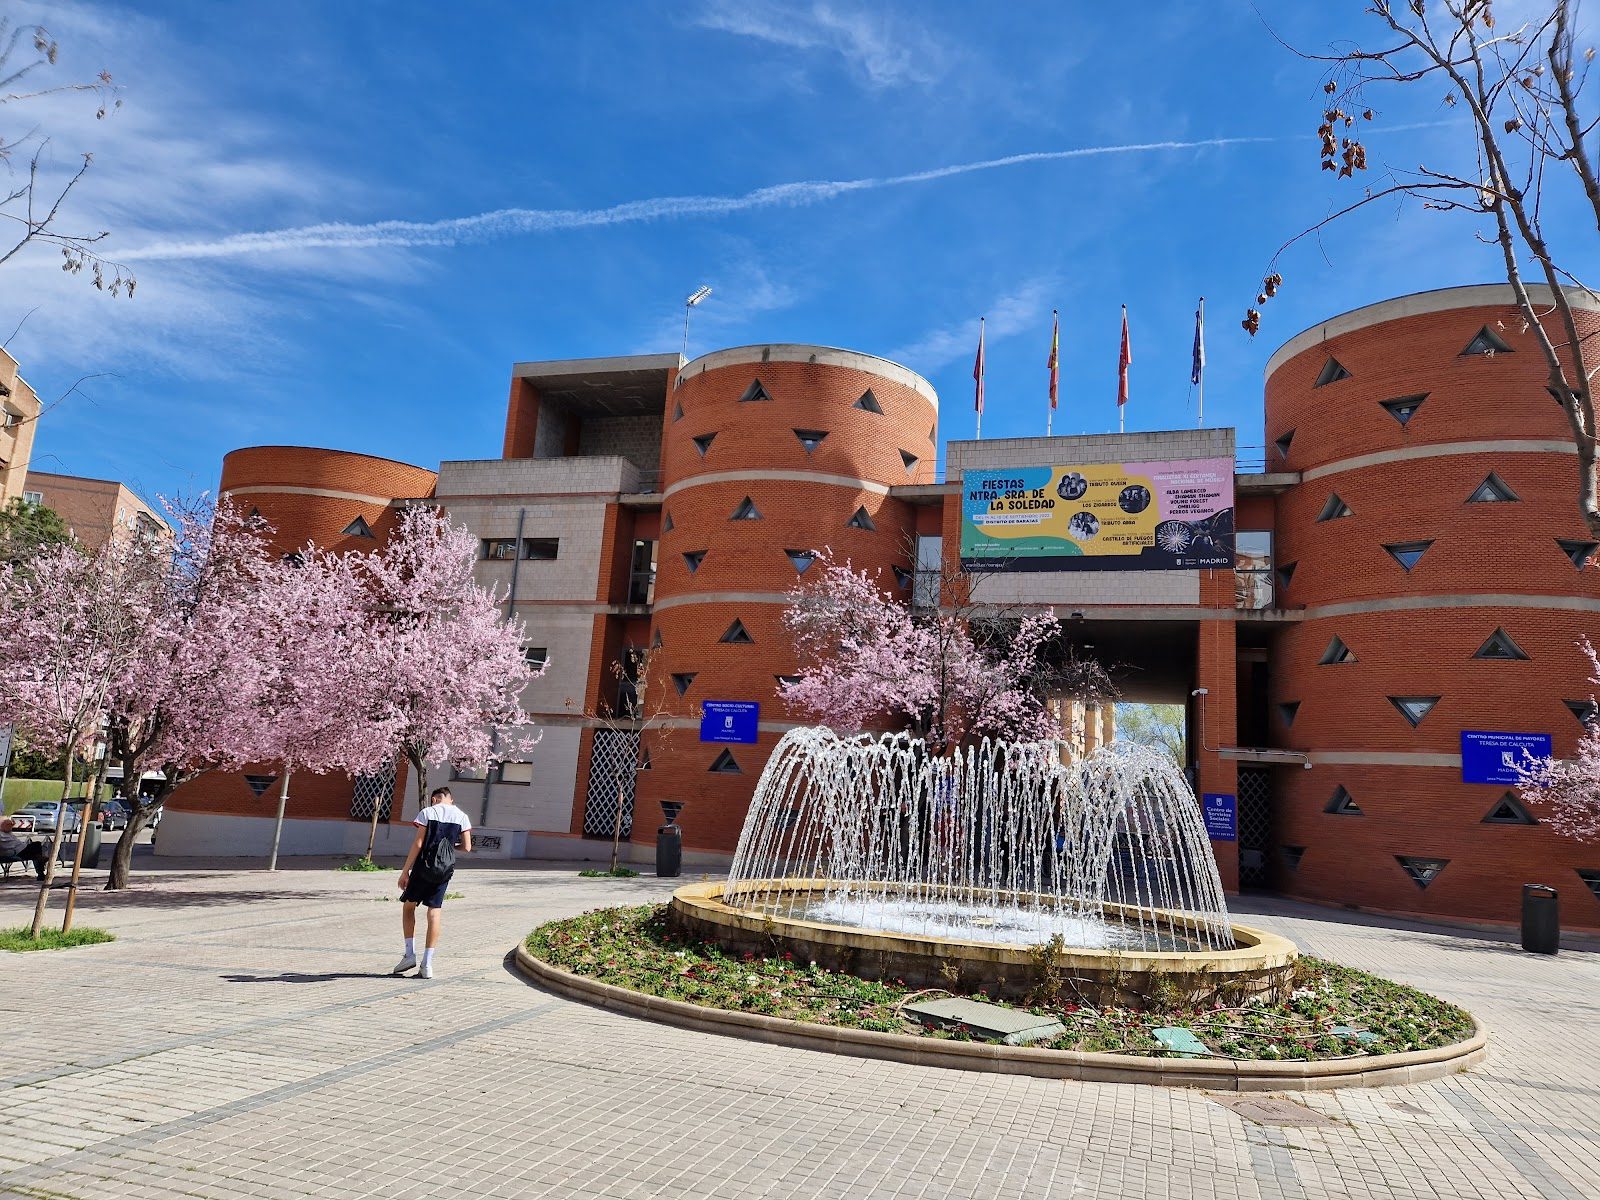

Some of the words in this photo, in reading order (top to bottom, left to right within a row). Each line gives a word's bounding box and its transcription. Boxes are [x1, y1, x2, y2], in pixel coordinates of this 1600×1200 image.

[982, 480, 1024, 490] FIESTAS
[970, 491, 1000, 500] NTRA.
[1004, 490, 1028, 499] SRA.
[1032, 489, 1045, 498] DE
[990, 501, 1004, 510] LA
[1008, 500, 1055, 510] SOLEDAD
